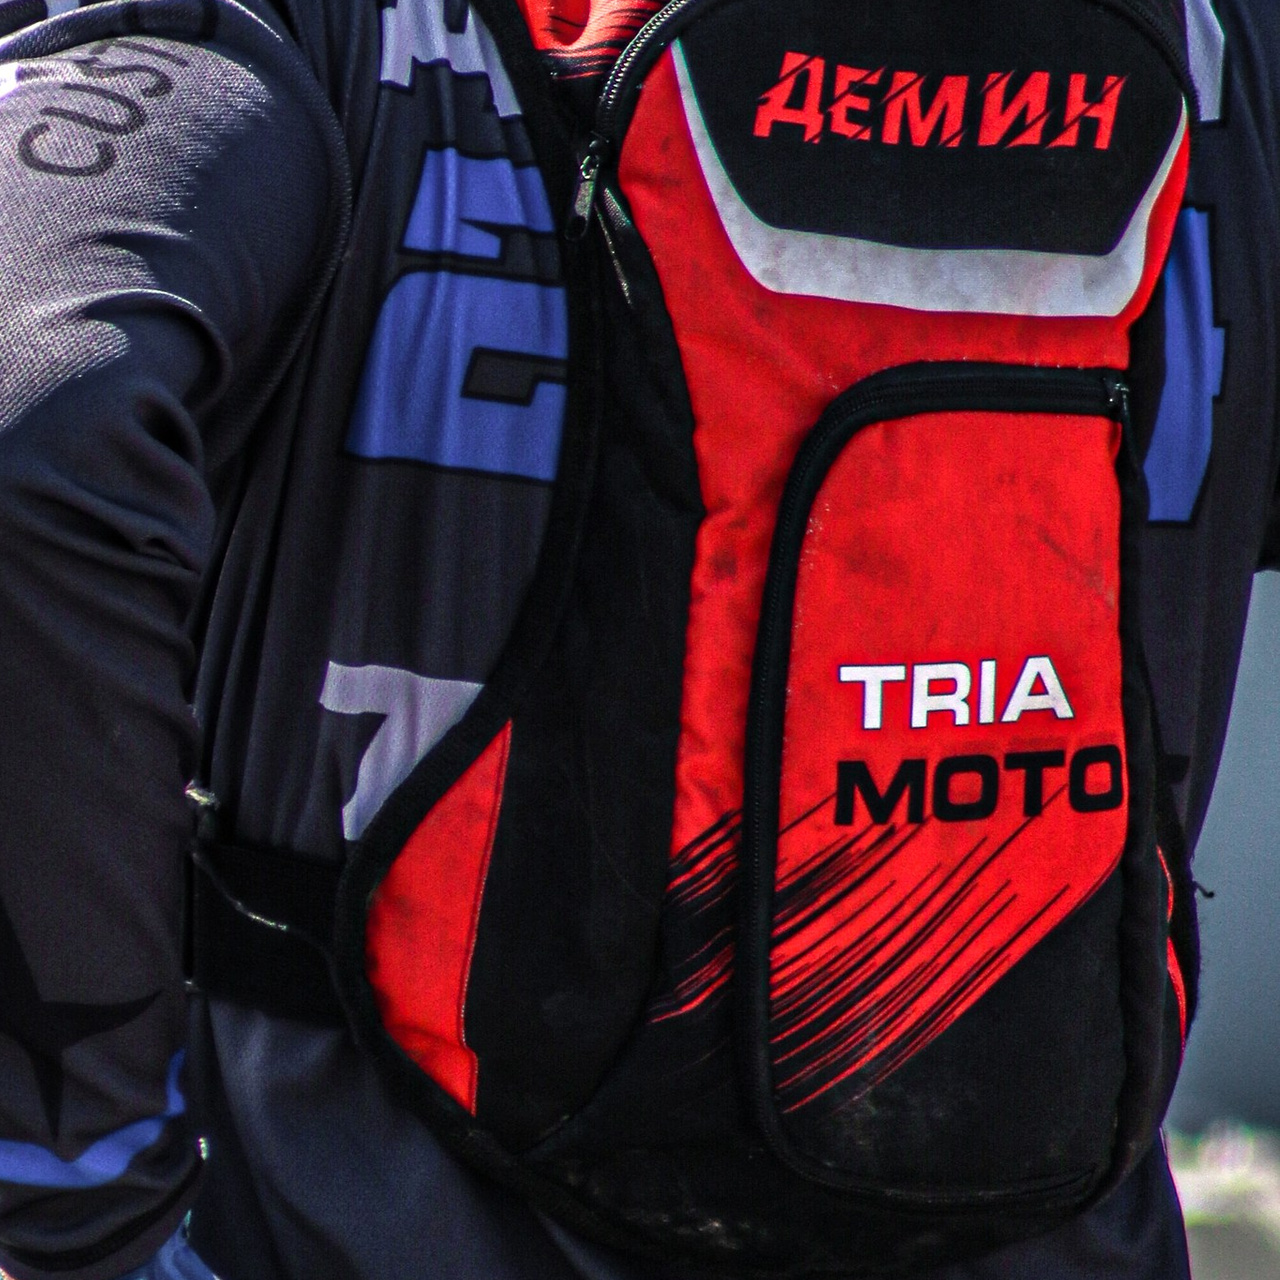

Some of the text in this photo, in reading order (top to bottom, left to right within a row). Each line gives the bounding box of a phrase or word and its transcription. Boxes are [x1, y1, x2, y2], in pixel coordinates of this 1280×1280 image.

[753, 50, 1129, 151] ДЕМИН
[839, 656, 1075, 731] TRIA
[833, 743, 1123, 827] MOTO
